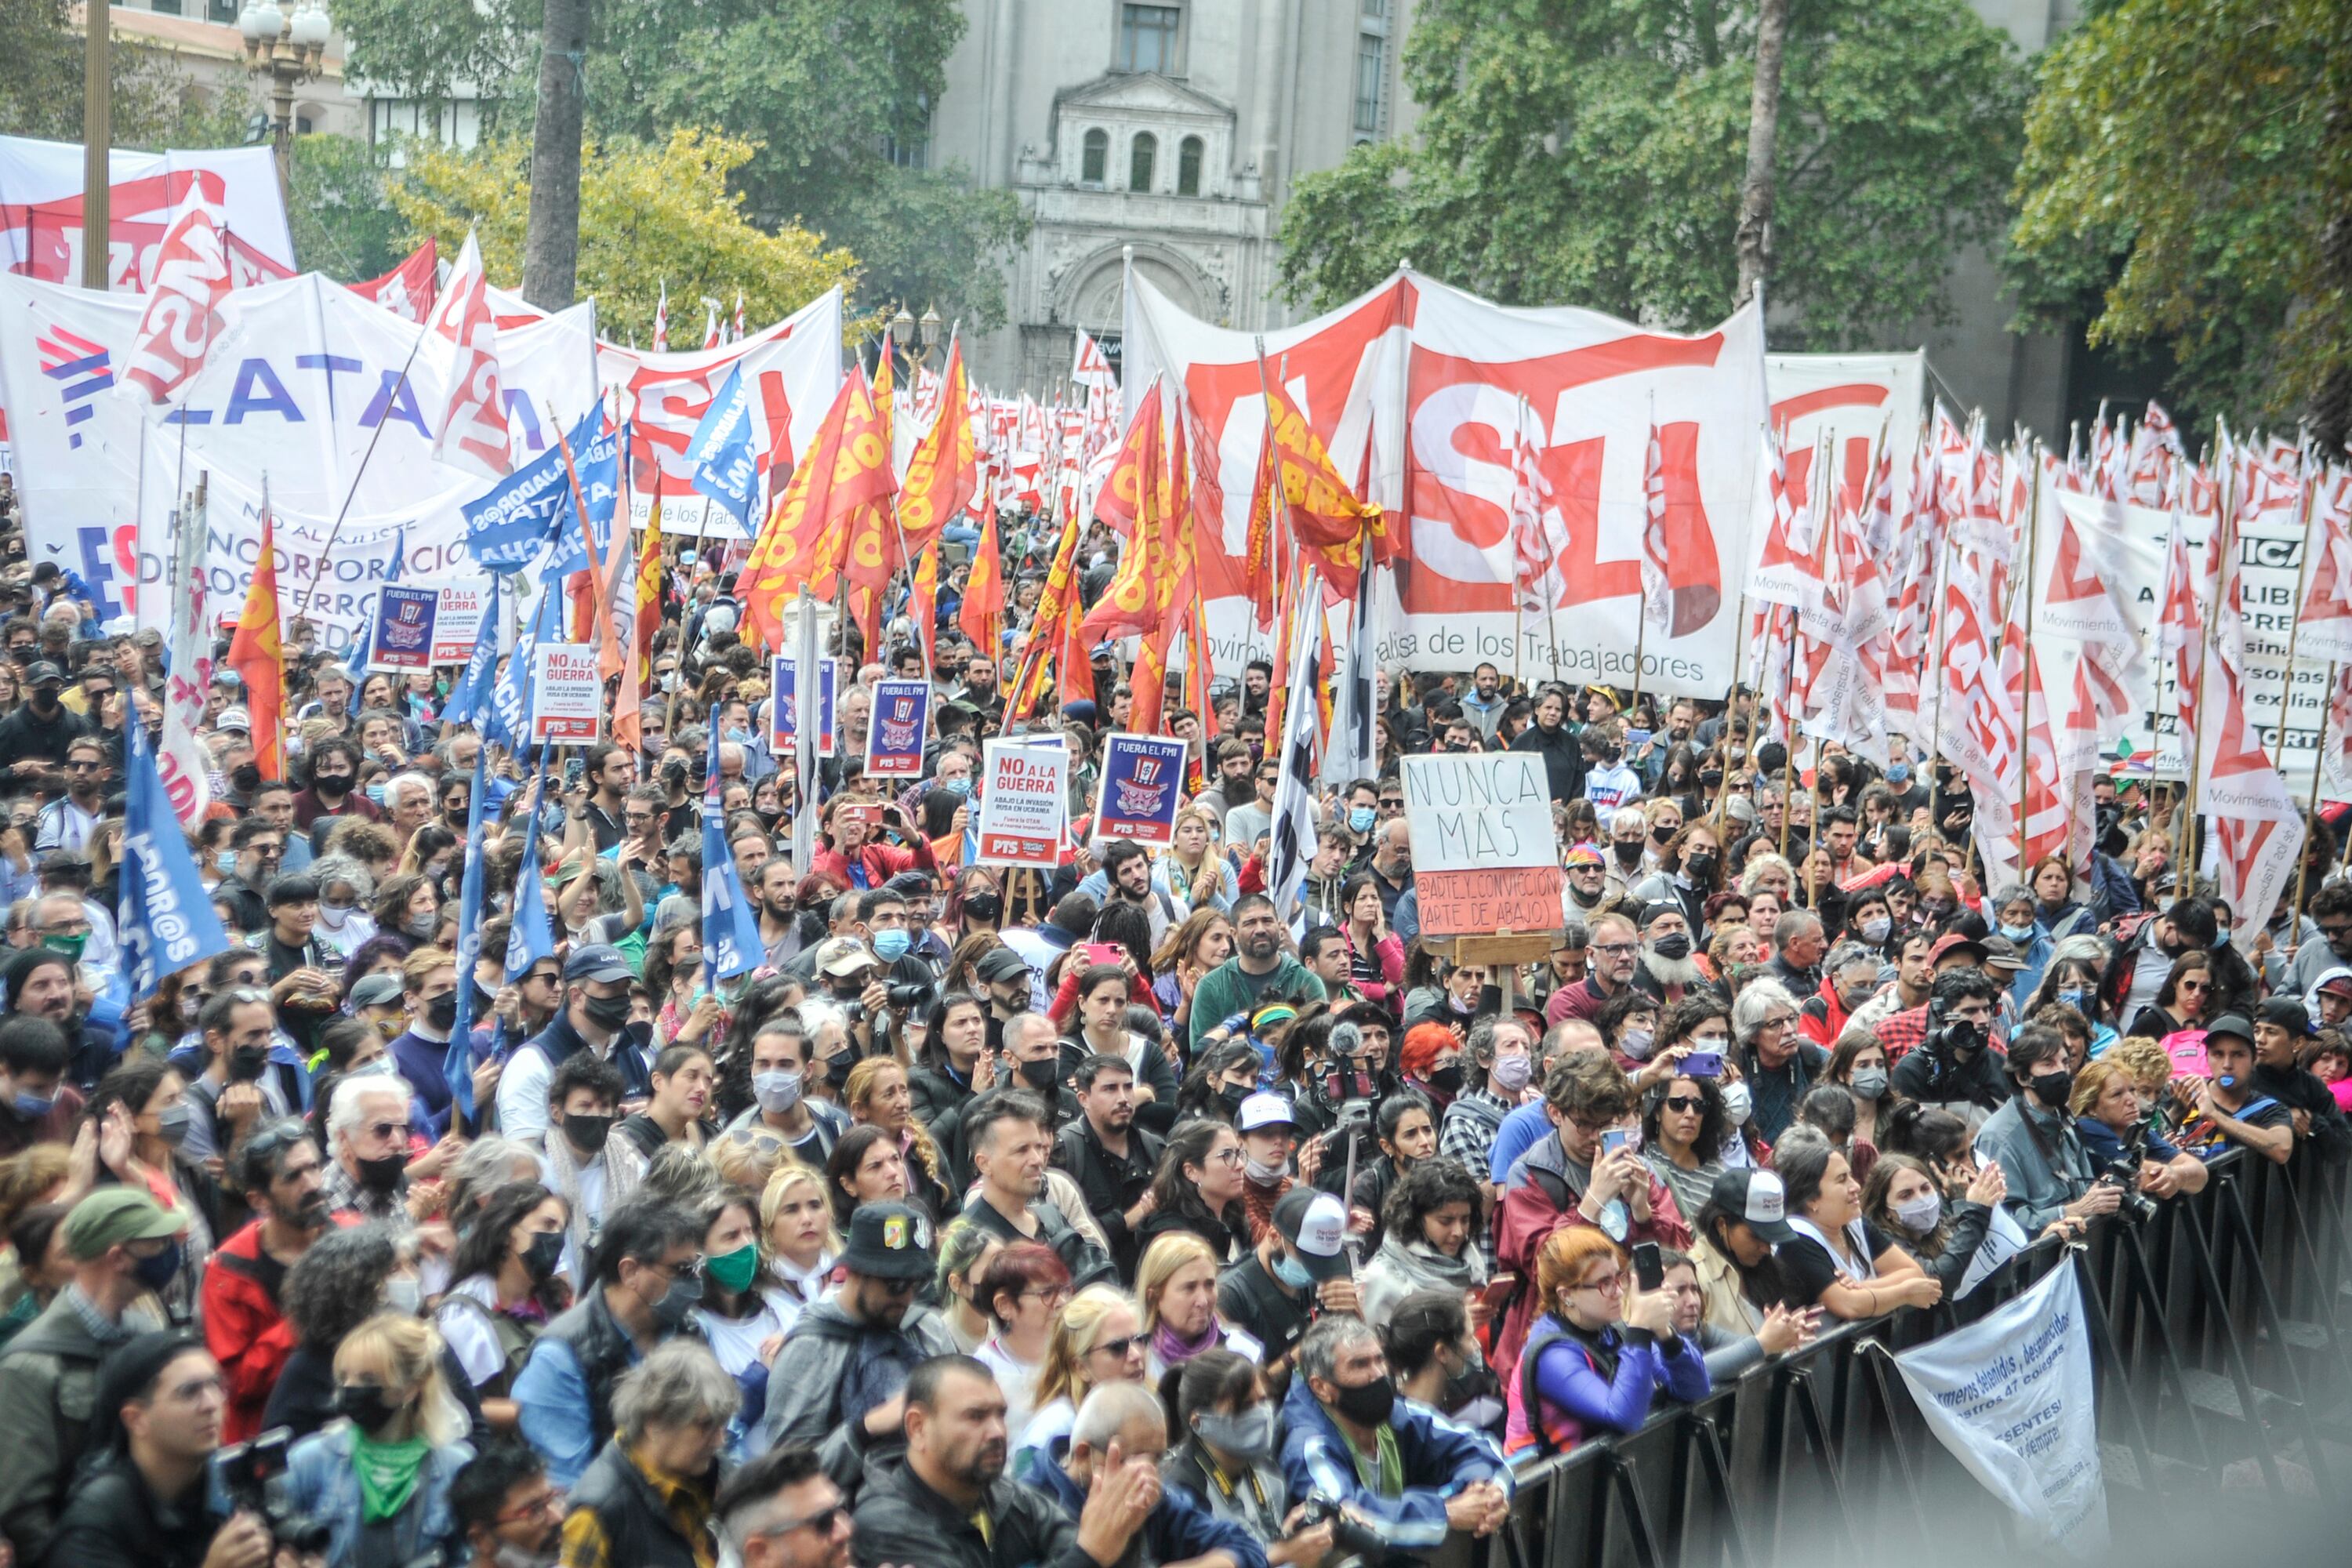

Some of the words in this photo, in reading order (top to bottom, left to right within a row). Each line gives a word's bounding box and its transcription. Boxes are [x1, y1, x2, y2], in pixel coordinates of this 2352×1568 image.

[387, 590, 411, 599] FUERA
[437, 647, 456, 656] PTS
[1429, 626, 1465, 655] de
[1477, 627, 1513, 657] los
[1527, 633, 1703, 681] Trabajadores
[548, 654, 568, 667] NO
[571, 659, 577, 668] A
[581, 659, 593, 668] LA
[546, 669, 593, 681] GUERRA
[882, 687, 902, 695] FUERA
[913, 687, 924, 696] FMI
[546, 721, 567, 732] PTS
[1117, 742, 1147, 754] FUERA
[1149, 746, 1160, 755] EL
[1161, 747, 1178, 757] FMI
[879, 758, 895, 768] PTS
[999, 757, 1024, 775] NO
[1028, 765, 1036, 776] A
[1040, 766, 1055, 778] LA
[996, 776, 1055, 793] GUERRA
[1406, 760, 1541, 807] NUNCA
[1025, 798, 1054, 807] INVASIÓN
[2208, 789, 2283, 811] Movimiento
[1113, 823, 1133, 833] PTS
[1437, 805, 1519, 860] MÁS
[992, 840, 1018, 854] PTS
[1471, 902, 1490, 926] DE
[2005, 1379, 2019, 1399] 47
[2023, 1344, 2065, 1385] colegas
